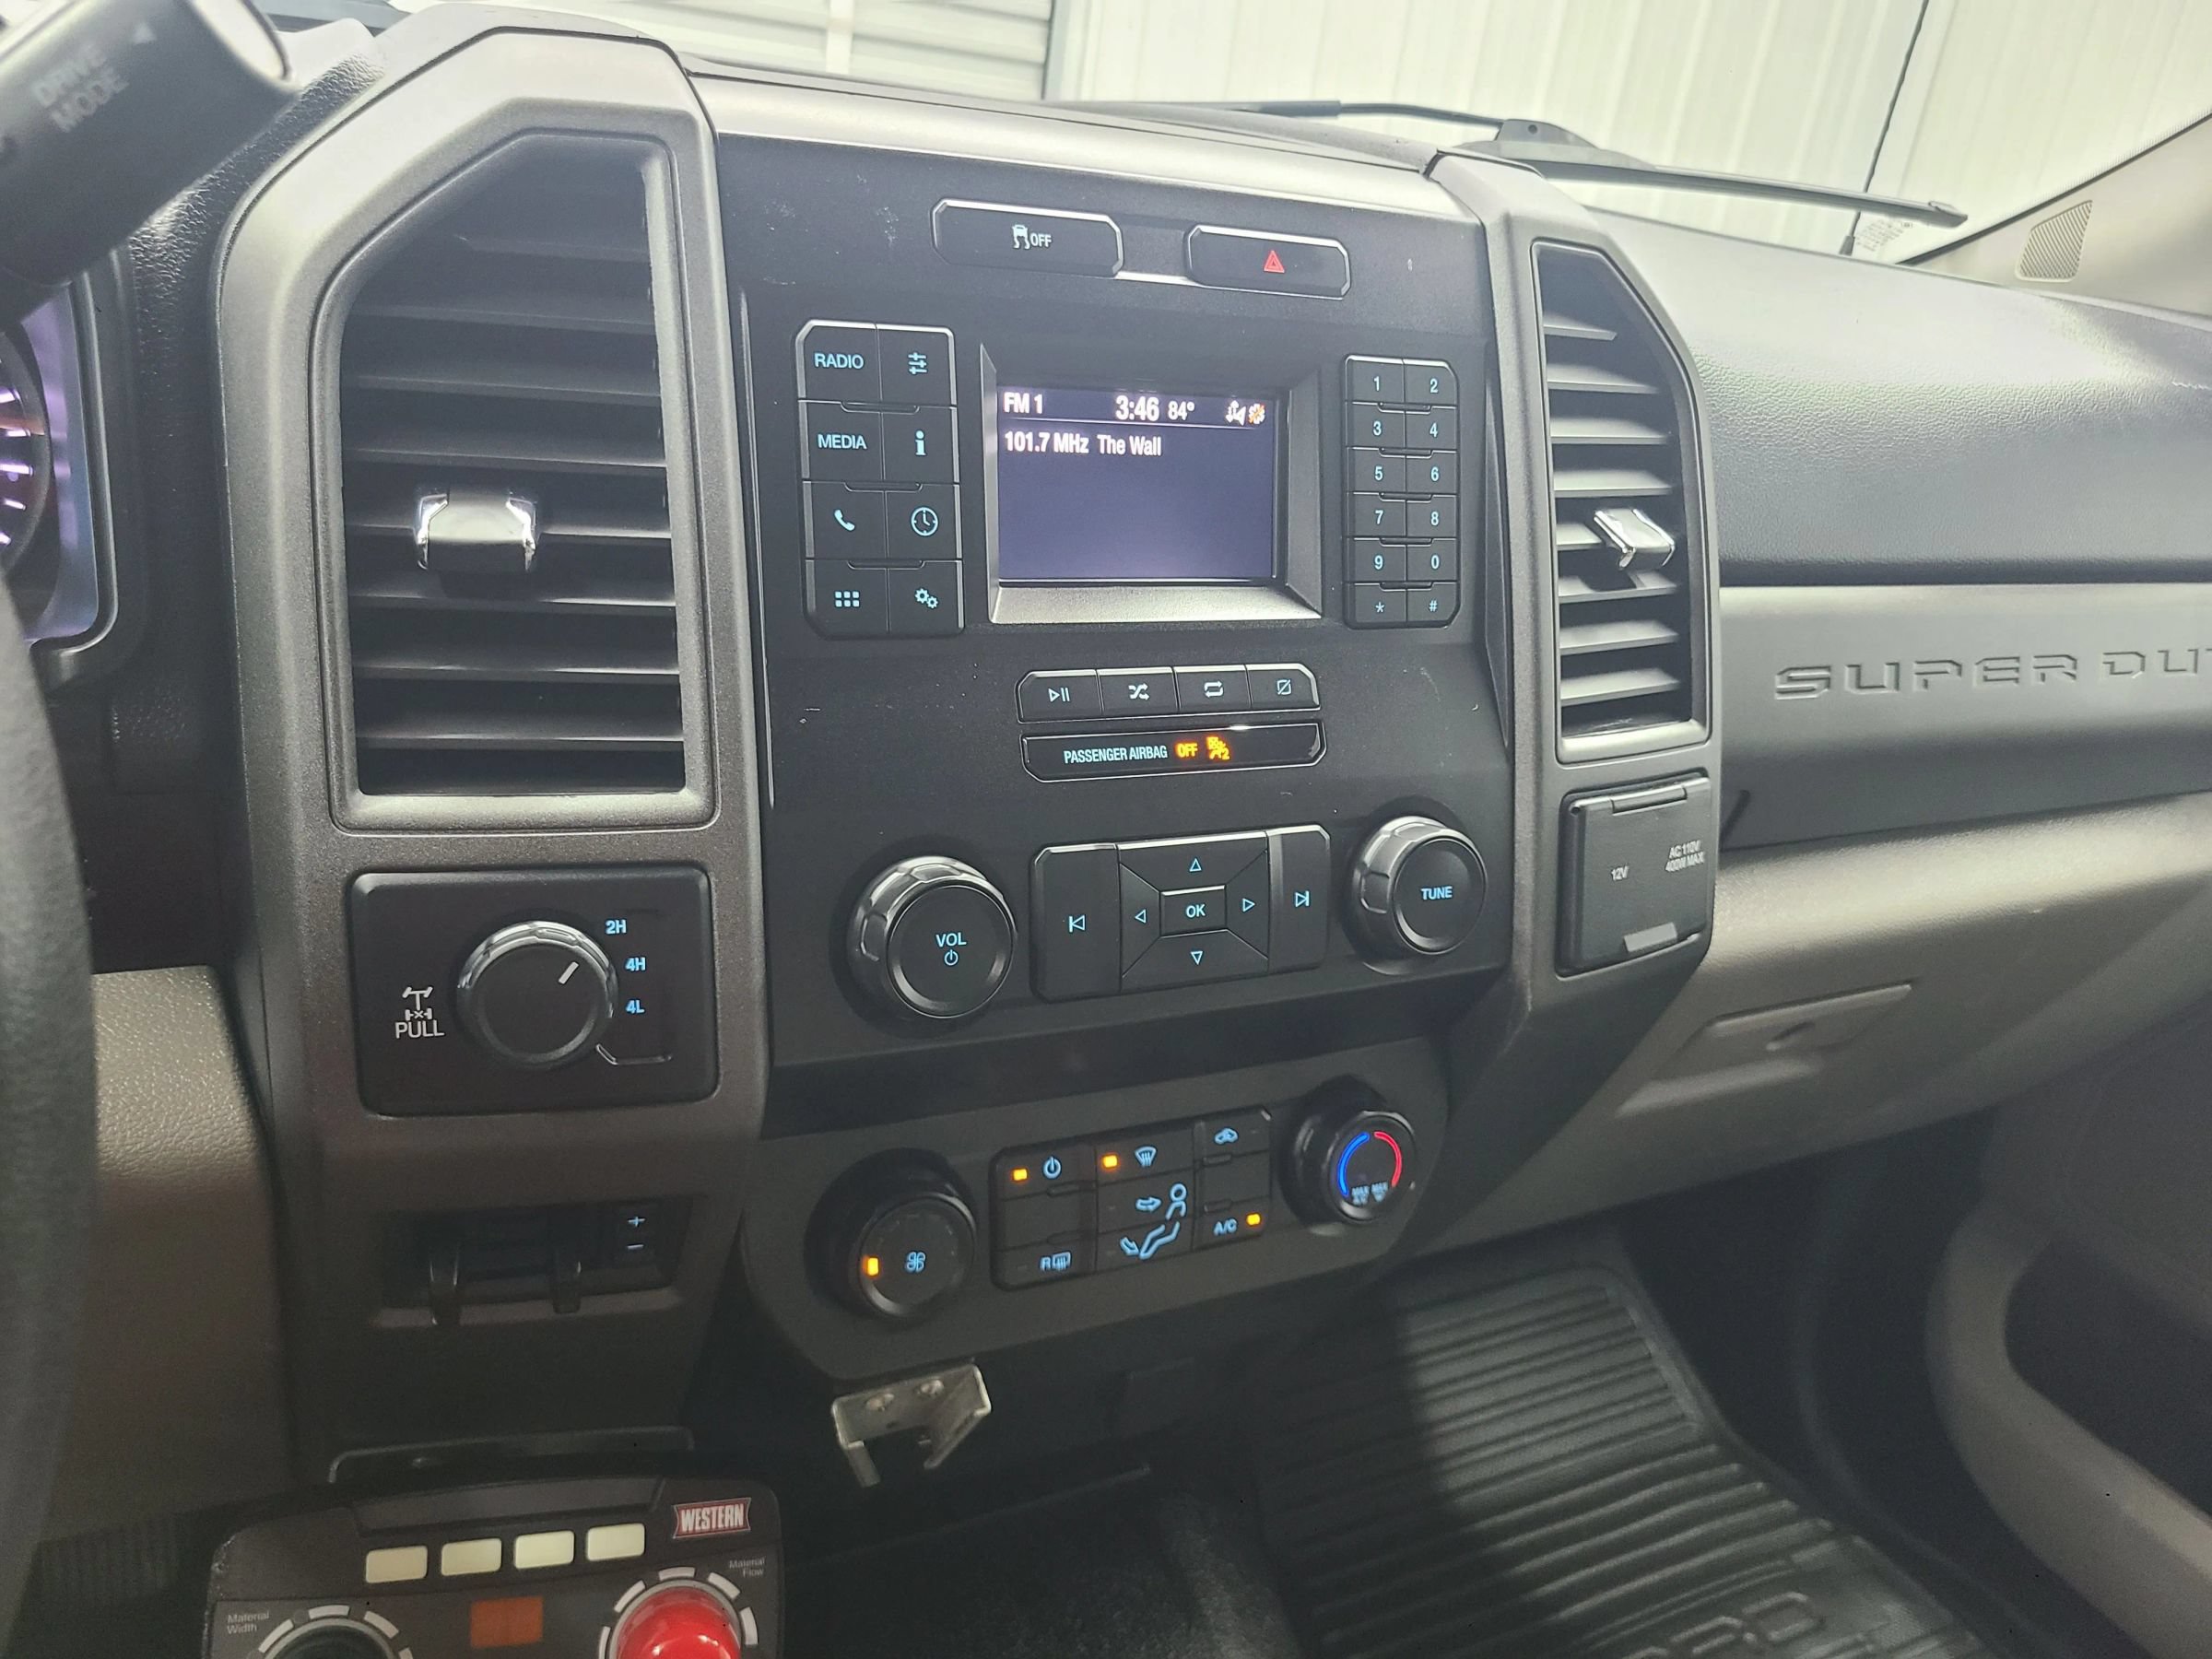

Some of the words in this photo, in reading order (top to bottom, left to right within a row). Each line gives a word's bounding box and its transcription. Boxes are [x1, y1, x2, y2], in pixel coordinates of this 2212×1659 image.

[51, 67, 130, 133] MODE
[1030, 233, 1053, 248] OFF
[814, 353, 865, 371] RADIO
[1373, 376, 1381, 392] 1
[1430, 378, 1439, 394] 2
[1004, 392, 1030, 414] FM
[1034, 394, 1043, 414] 1
[1115, 395, 1159, 421] 3:46
[1373, 420, 1382, 436] 3
[1430, 422, 1439, 438] 4
[818, 434, 867, 451] MEDIA
[1004, 431, 1051, 453] 101.7
[1053, 432, 1089, 454] MHz
[1097, 433, 1125, 455] The
[1129, 435, 1162, 456] Wall
[1374, 466, 1383, 481] 5
[1430, 466, 1440, 482] 6
[1375, 510, 1384, 525] 7
[1430, 512, 1440, 526] 8
[1374, 555, 1383, 570] 9
[1430, 555, 1440, 570] 0
[1774, 653, 2078, 700] SUPER
[2101, 648, 2212, 679] DU
[1064, 746, 1128, 764] PASSENGER
[1129, 744, 1168, 760] AIRBAG
[1176, 742, 1198, 759] OFF
[1687, 851, 1705, 866] MAX
[1611, 865, 1630, 881] 12V
[1420, 885, 1453, 900] TUNE
[1185, 903, 1206, 919] OK
[606, 919, 627, 935] 2H
[935, 932, 968, 947] VOL
[625, 957, 646, 972] 4H
[626, 999, 645, 1015] 4L
[394, 1019, 445, 1039] PULL
[1214, 1218, 1238, 1237] A/C
[681, 1503, 745, 1533] WESTERN
[729, 1556, 766, 1570] Material
[742, 1569, 765, 1578] Flow
[227, 1610, 270, 1624] Material
[227, 1622, 257, 1635] Width
